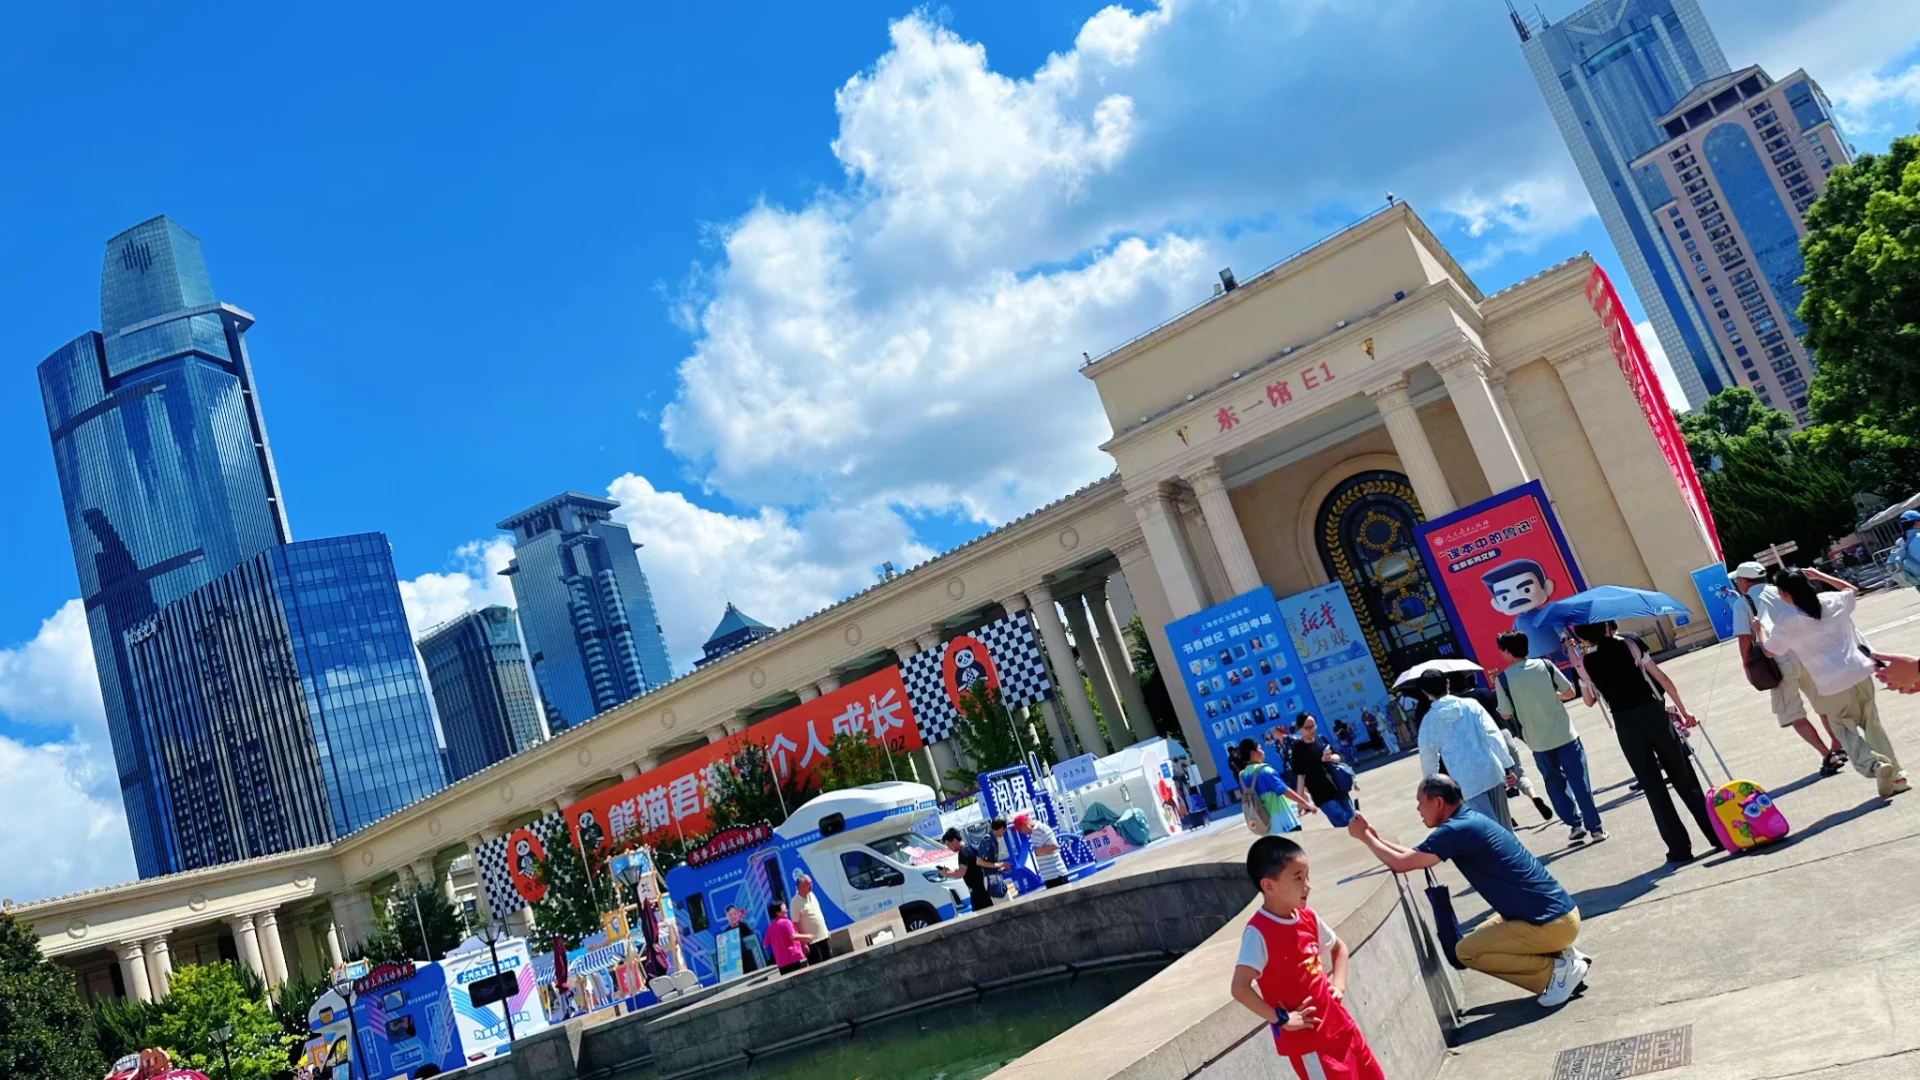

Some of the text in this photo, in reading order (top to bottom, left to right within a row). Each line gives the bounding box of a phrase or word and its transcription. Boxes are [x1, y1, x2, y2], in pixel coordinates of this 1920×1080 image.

[1213, 361, 1336, 434] 东一馆 E1
[1181, 630, 1226, 655] 书香世纪
